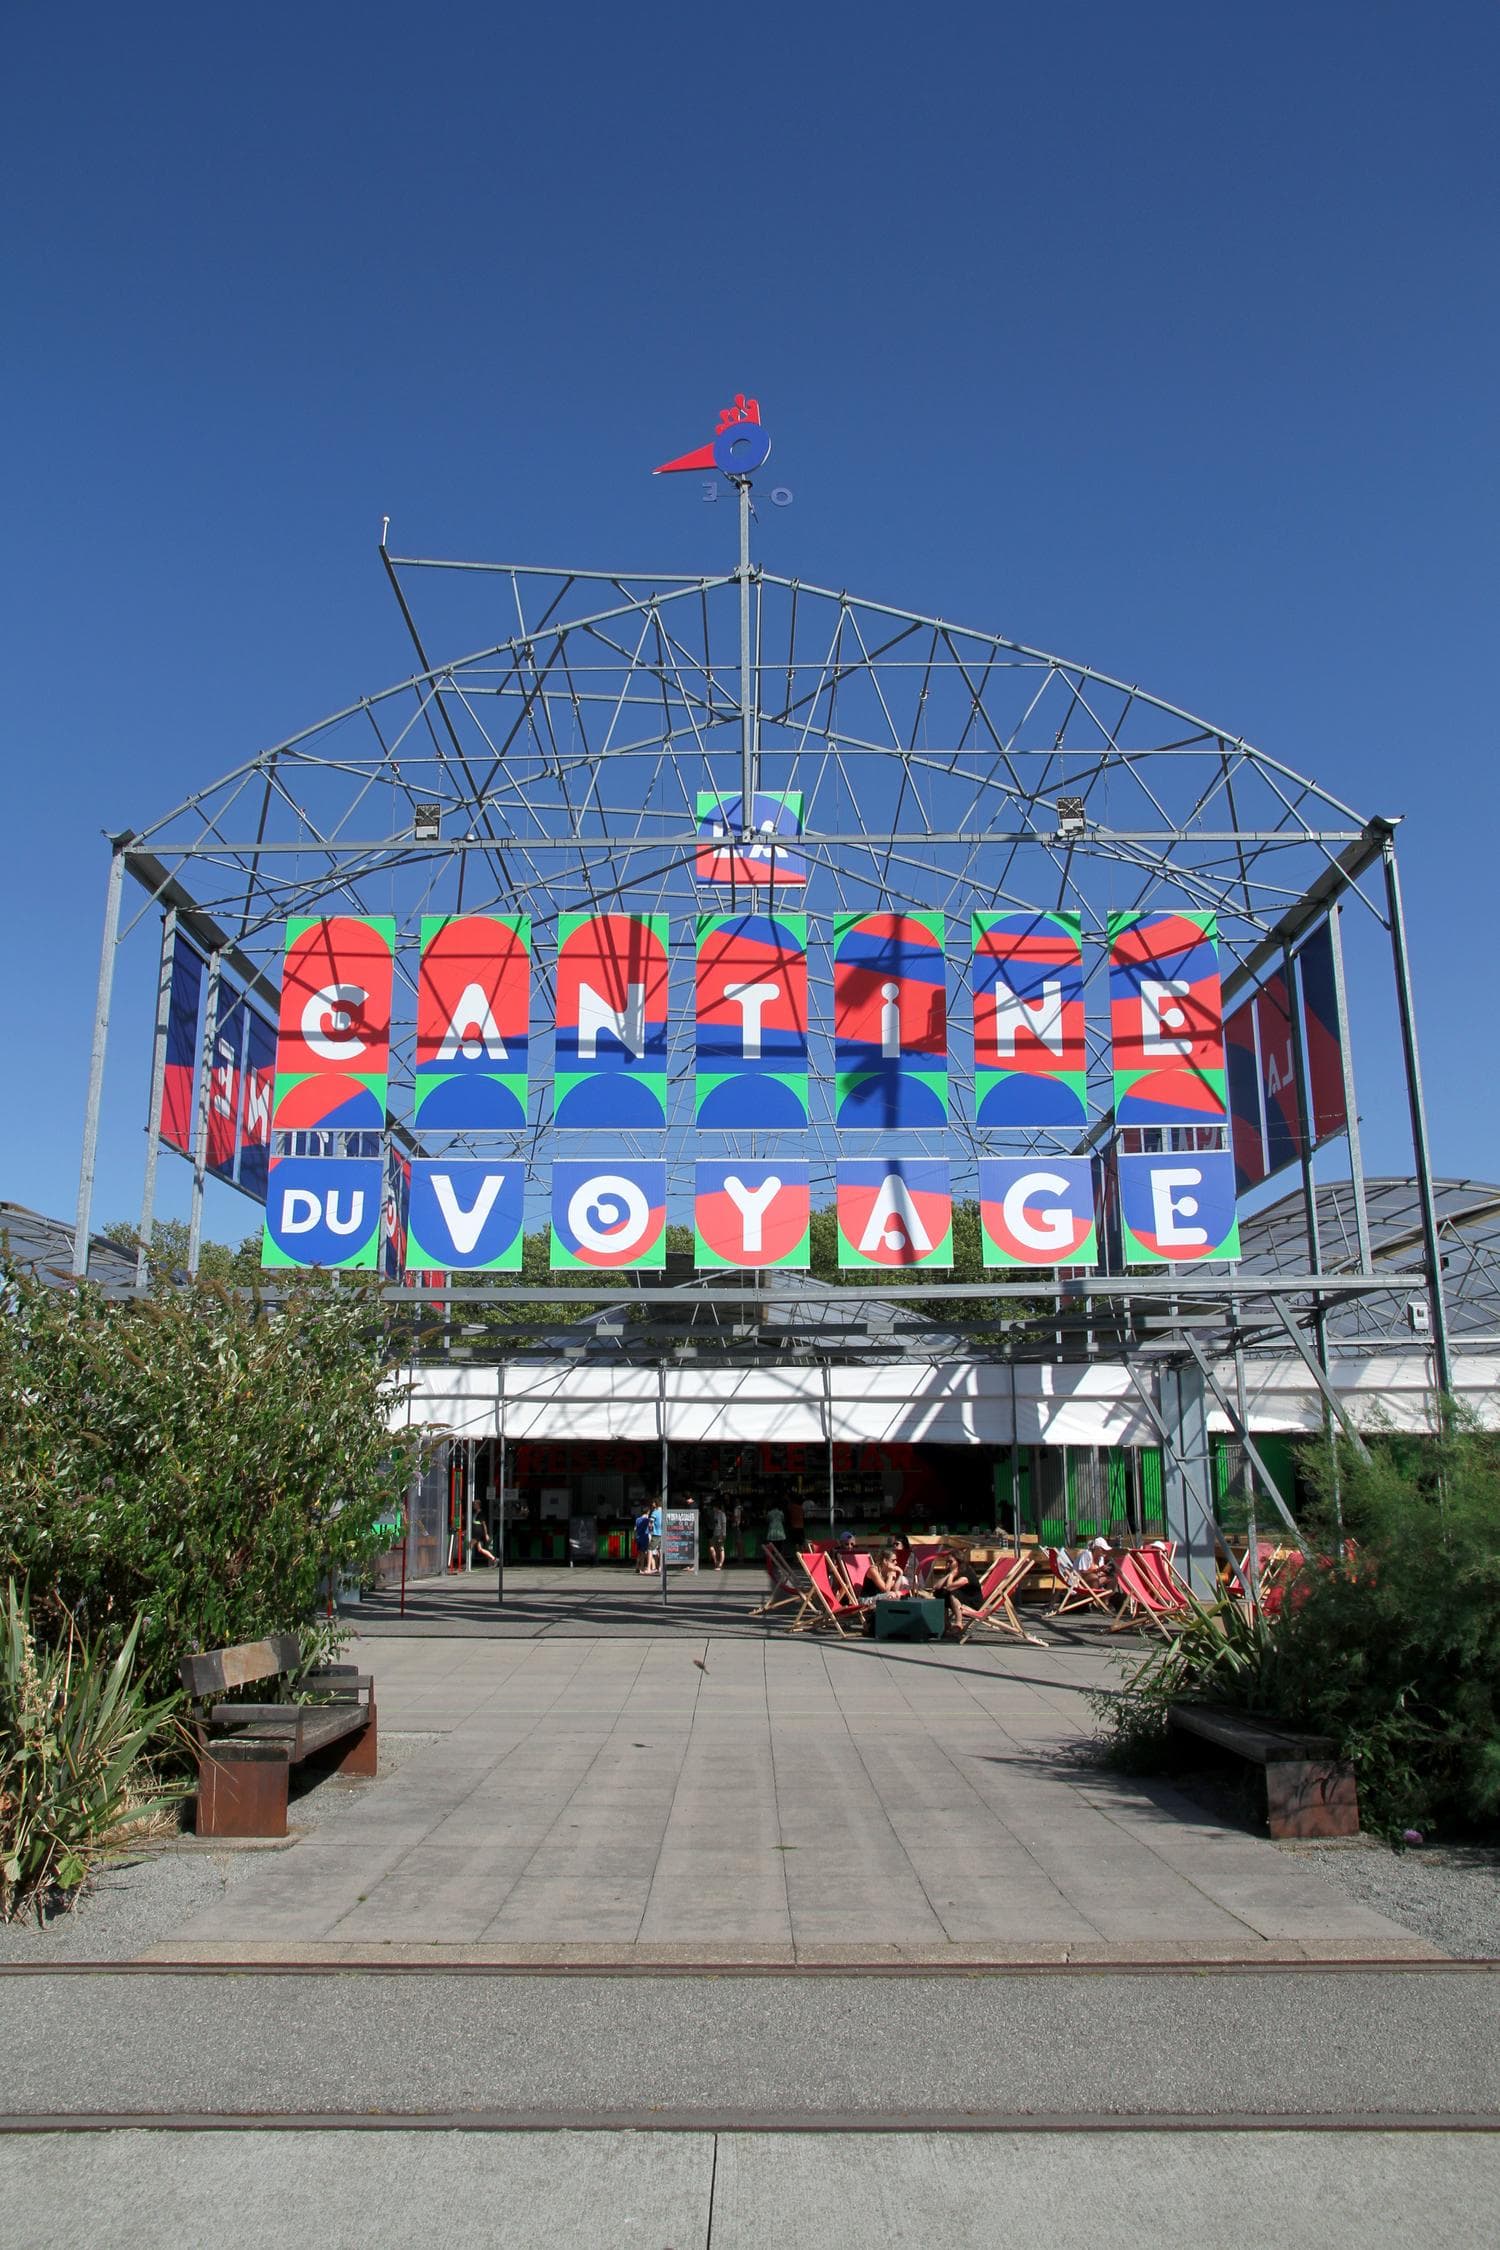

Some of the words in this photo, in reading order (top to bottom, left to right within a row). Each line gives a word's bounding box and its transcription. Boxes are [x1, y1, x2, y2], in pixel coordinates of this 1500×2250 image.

[713, 820, 788, 858] LA
[281, 1189, 364, 1235] DU
[430, 1168, 1208, 1254] VOYAGE
